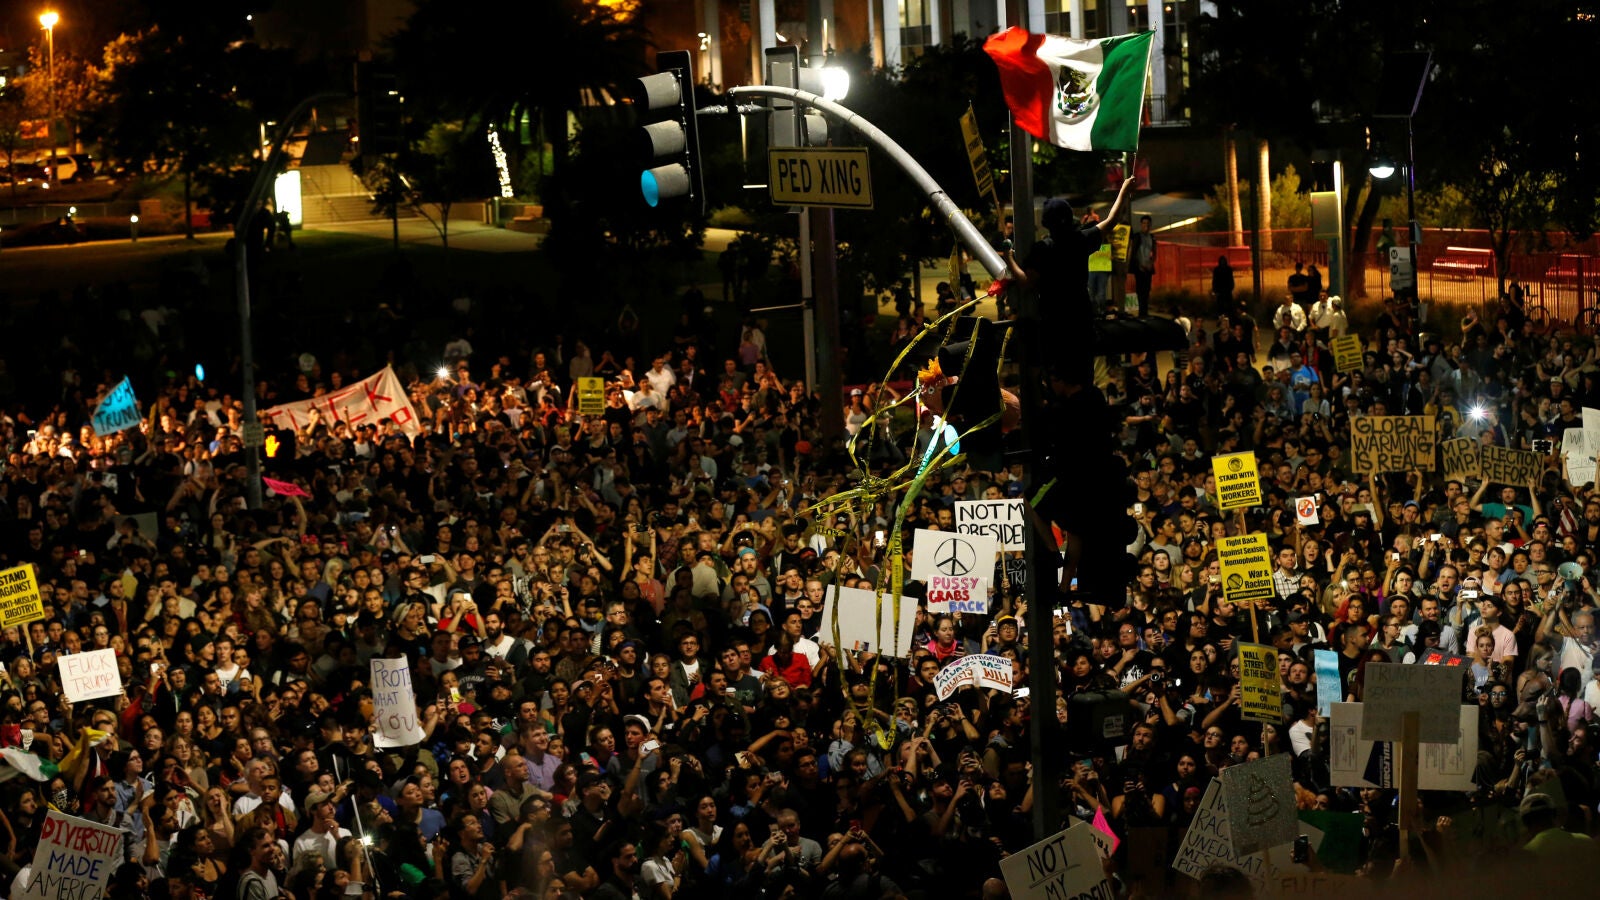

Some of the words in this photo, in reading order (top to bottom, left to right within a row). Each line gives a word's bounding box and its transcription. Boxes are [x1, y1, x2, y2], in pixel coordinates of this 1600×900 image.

[778, 158, 812, 193] PED
[818, 159, 862, 196] XING
[1355, 417, 1433, 435] GLOBAL
[1353, 434, 1434, 453] WARMING
[1355, 451, 1374, 470] IS
[1482, 445, 1544, 468] ELECTION
[1219, 473, 1238, 482] STAND
[1482, 460, 1542, 486] REFORM
[1220, 481, 1256, 492] IMMIGRANT
[1221, 489, 1257, 501] WORKERS!
[960, 503, 1005, 521] NOT
[1008, 503, 1025, 521] M
[1221, 549, 1243, 557] Against
[0, 569, 27, 586] STAND
[1248, 570, 1262, 578] War
[1264, 569, 1269, 577] &
[933, 576, 979, 590] PUSSY
[1244, 579, 1271, 589] Racism
[929, 590, 970, 603] GRABS
[5, 602, 38, 619] BIGOTRY!
[949, 601, 985, 613] BACK
[1243, 651, 1259, 660] WALL
[68, 654, 113, 676] FUCK
[1244, 660, 1264, 669] STREET
[70, 672, 114, 693] TRUMP
[983, 668, 1012, 685] WILL
[1251, 670, 1259, 678] THE
[374, 692, 399, 706] WHAT
[41, 816, 121, 857] DIVERSITY
[48, 850, 103, 880] MADE
[1027, 836, 1068, 881] NOT
